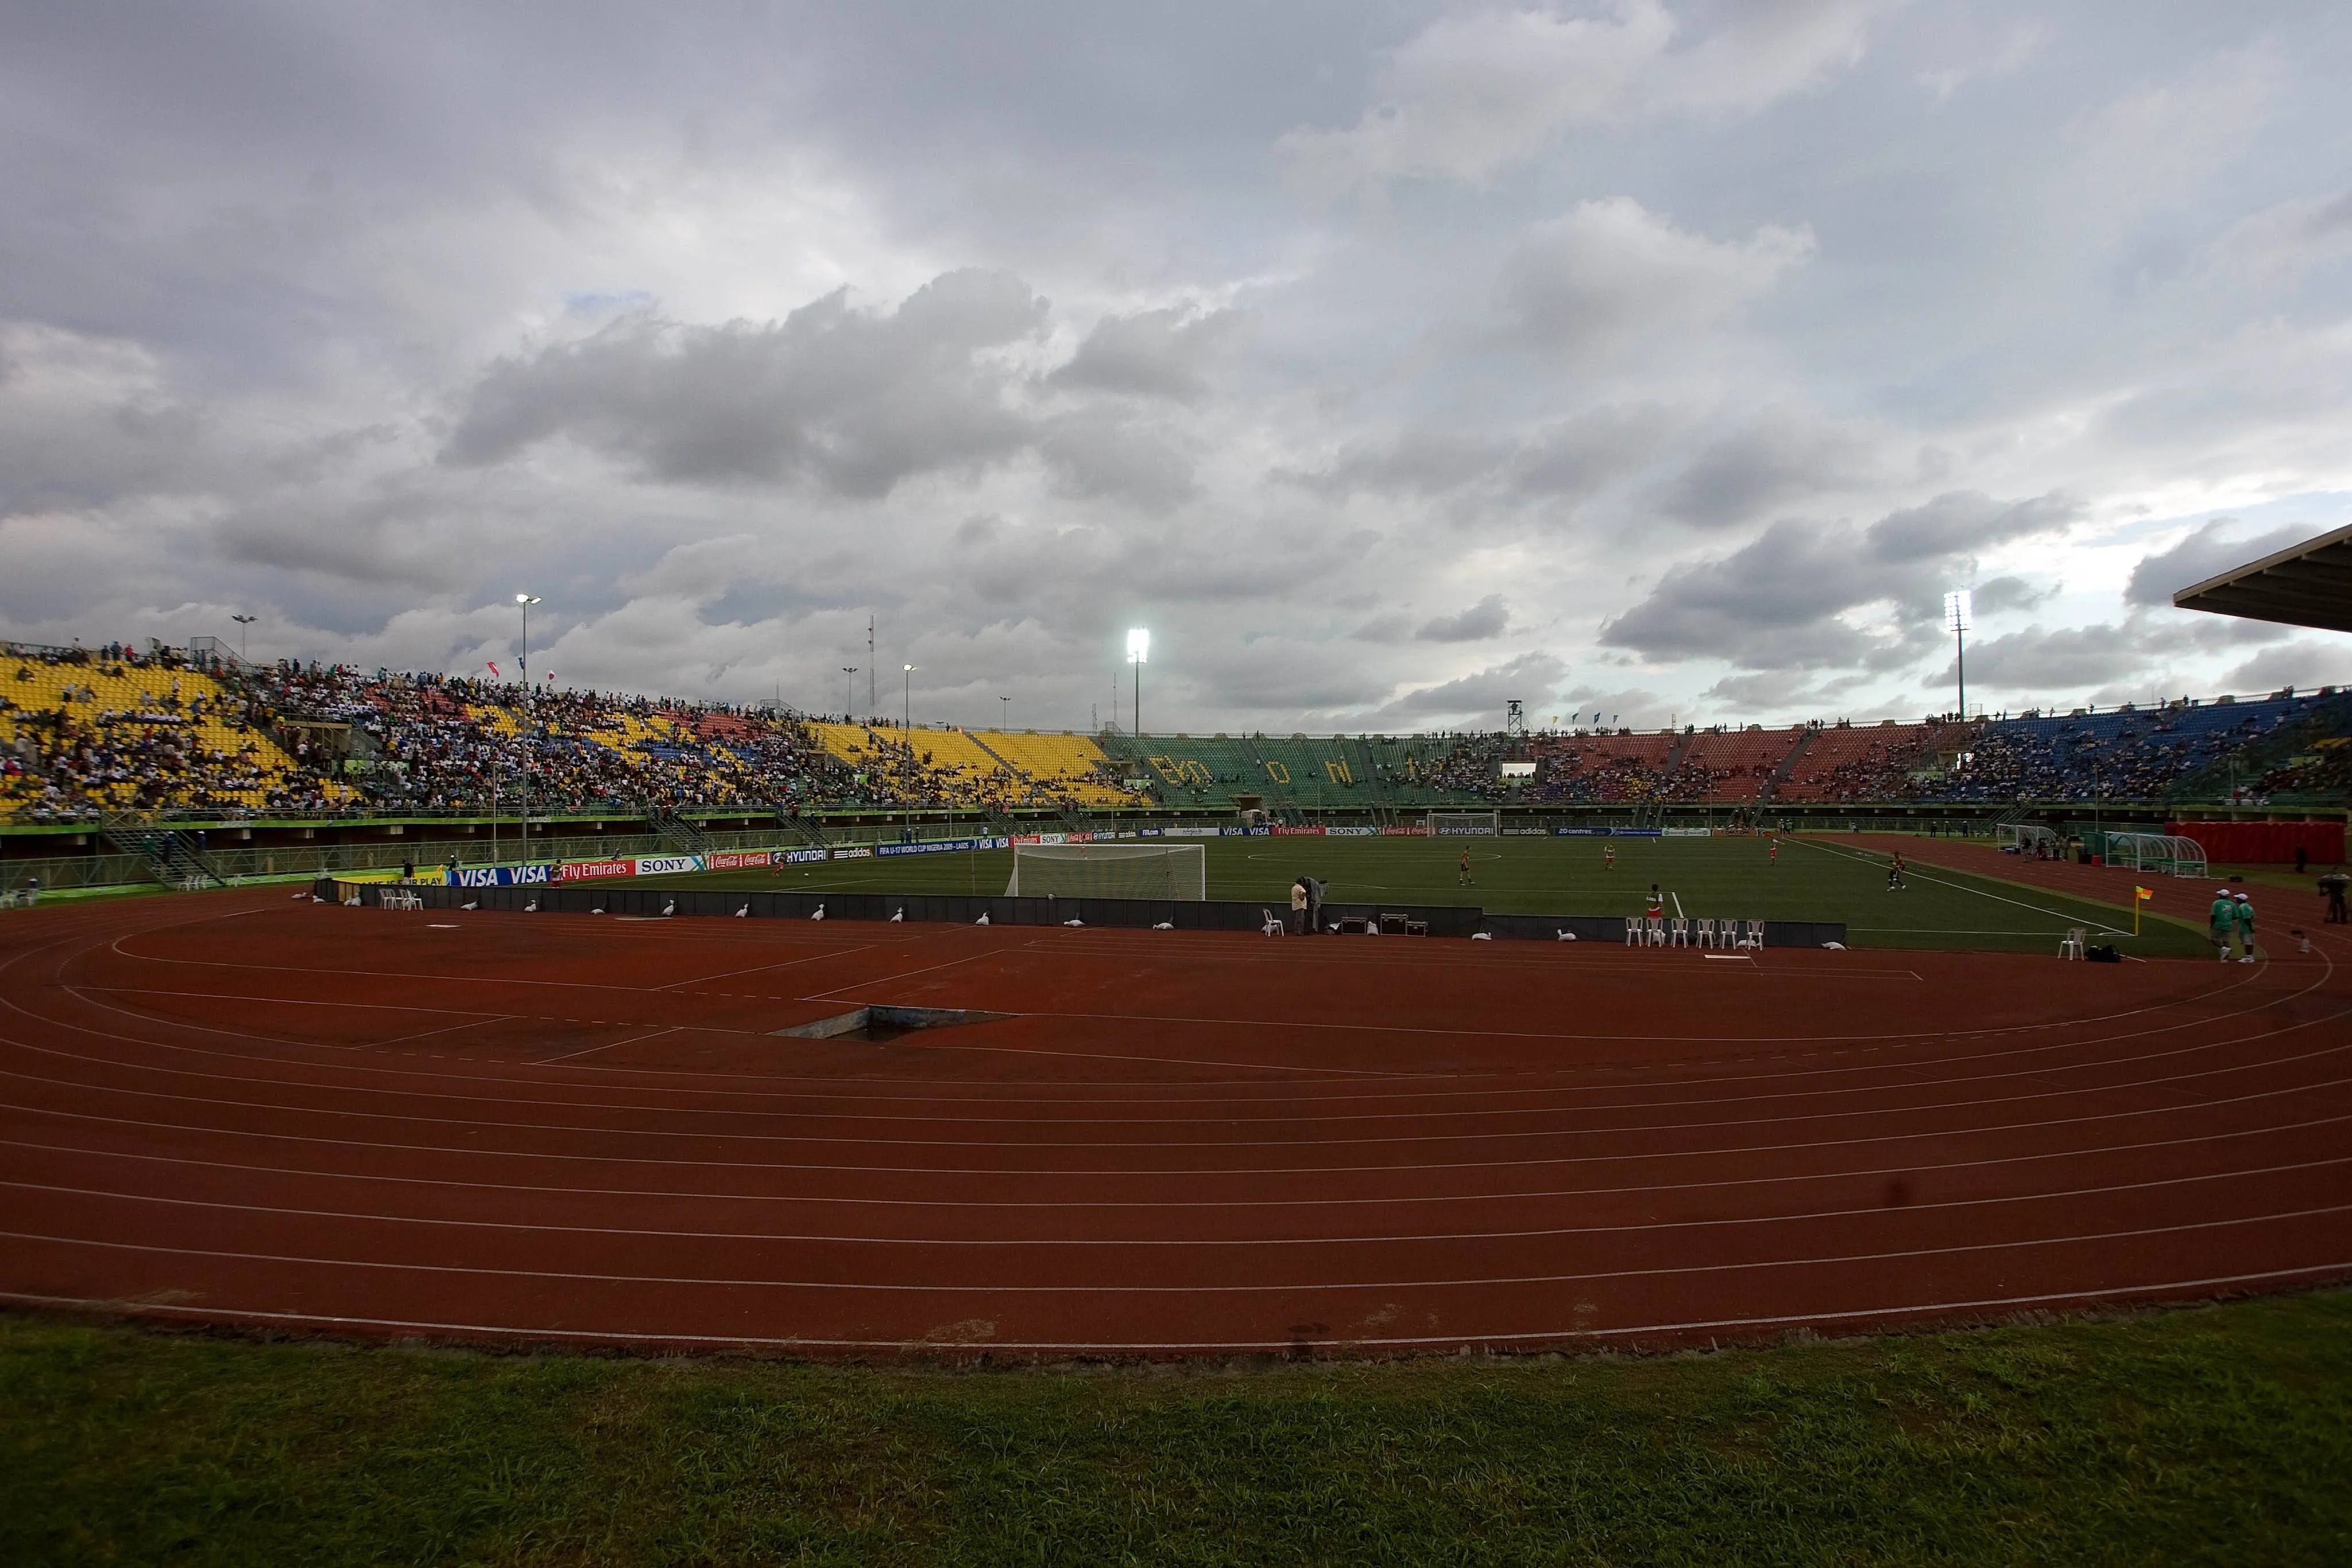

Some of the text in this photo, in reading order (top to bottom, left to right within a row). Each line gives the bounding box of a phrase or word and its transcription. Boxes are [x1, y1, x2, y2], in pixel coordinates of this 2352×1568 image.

[1223, 827, 1243, 836] VISA
[1249, 827, 1270, 836] VISA
[1278, 827, 1320, 835] Fly Emirates
[978, 838, 992, 849] VISA
[996, 838, 1009, 849] VISA
[1042, 835, 1059, 843] SONY
[848, 847, 871, 858] adidas
[880, 847, 889, 855] FIFA
[890, 846, 900, 854] U-17
[901, 845, 917, 853] WORLD
[926, 843, 943, 851] NIGERIA
[715, 855, 738, 868] Coca-Cola
[744, 854, 765, 866] Coca-Cola
[787, 850, 826, 862] HYUNDAI
[562, 861, 627, 880] Fly Emirates
[641, 858, 686, 872] SONY
[457, 868, 498, 887] VISA
[508, 865, 547, 884] VISA
[420, 877, 442, 885] PLAY
